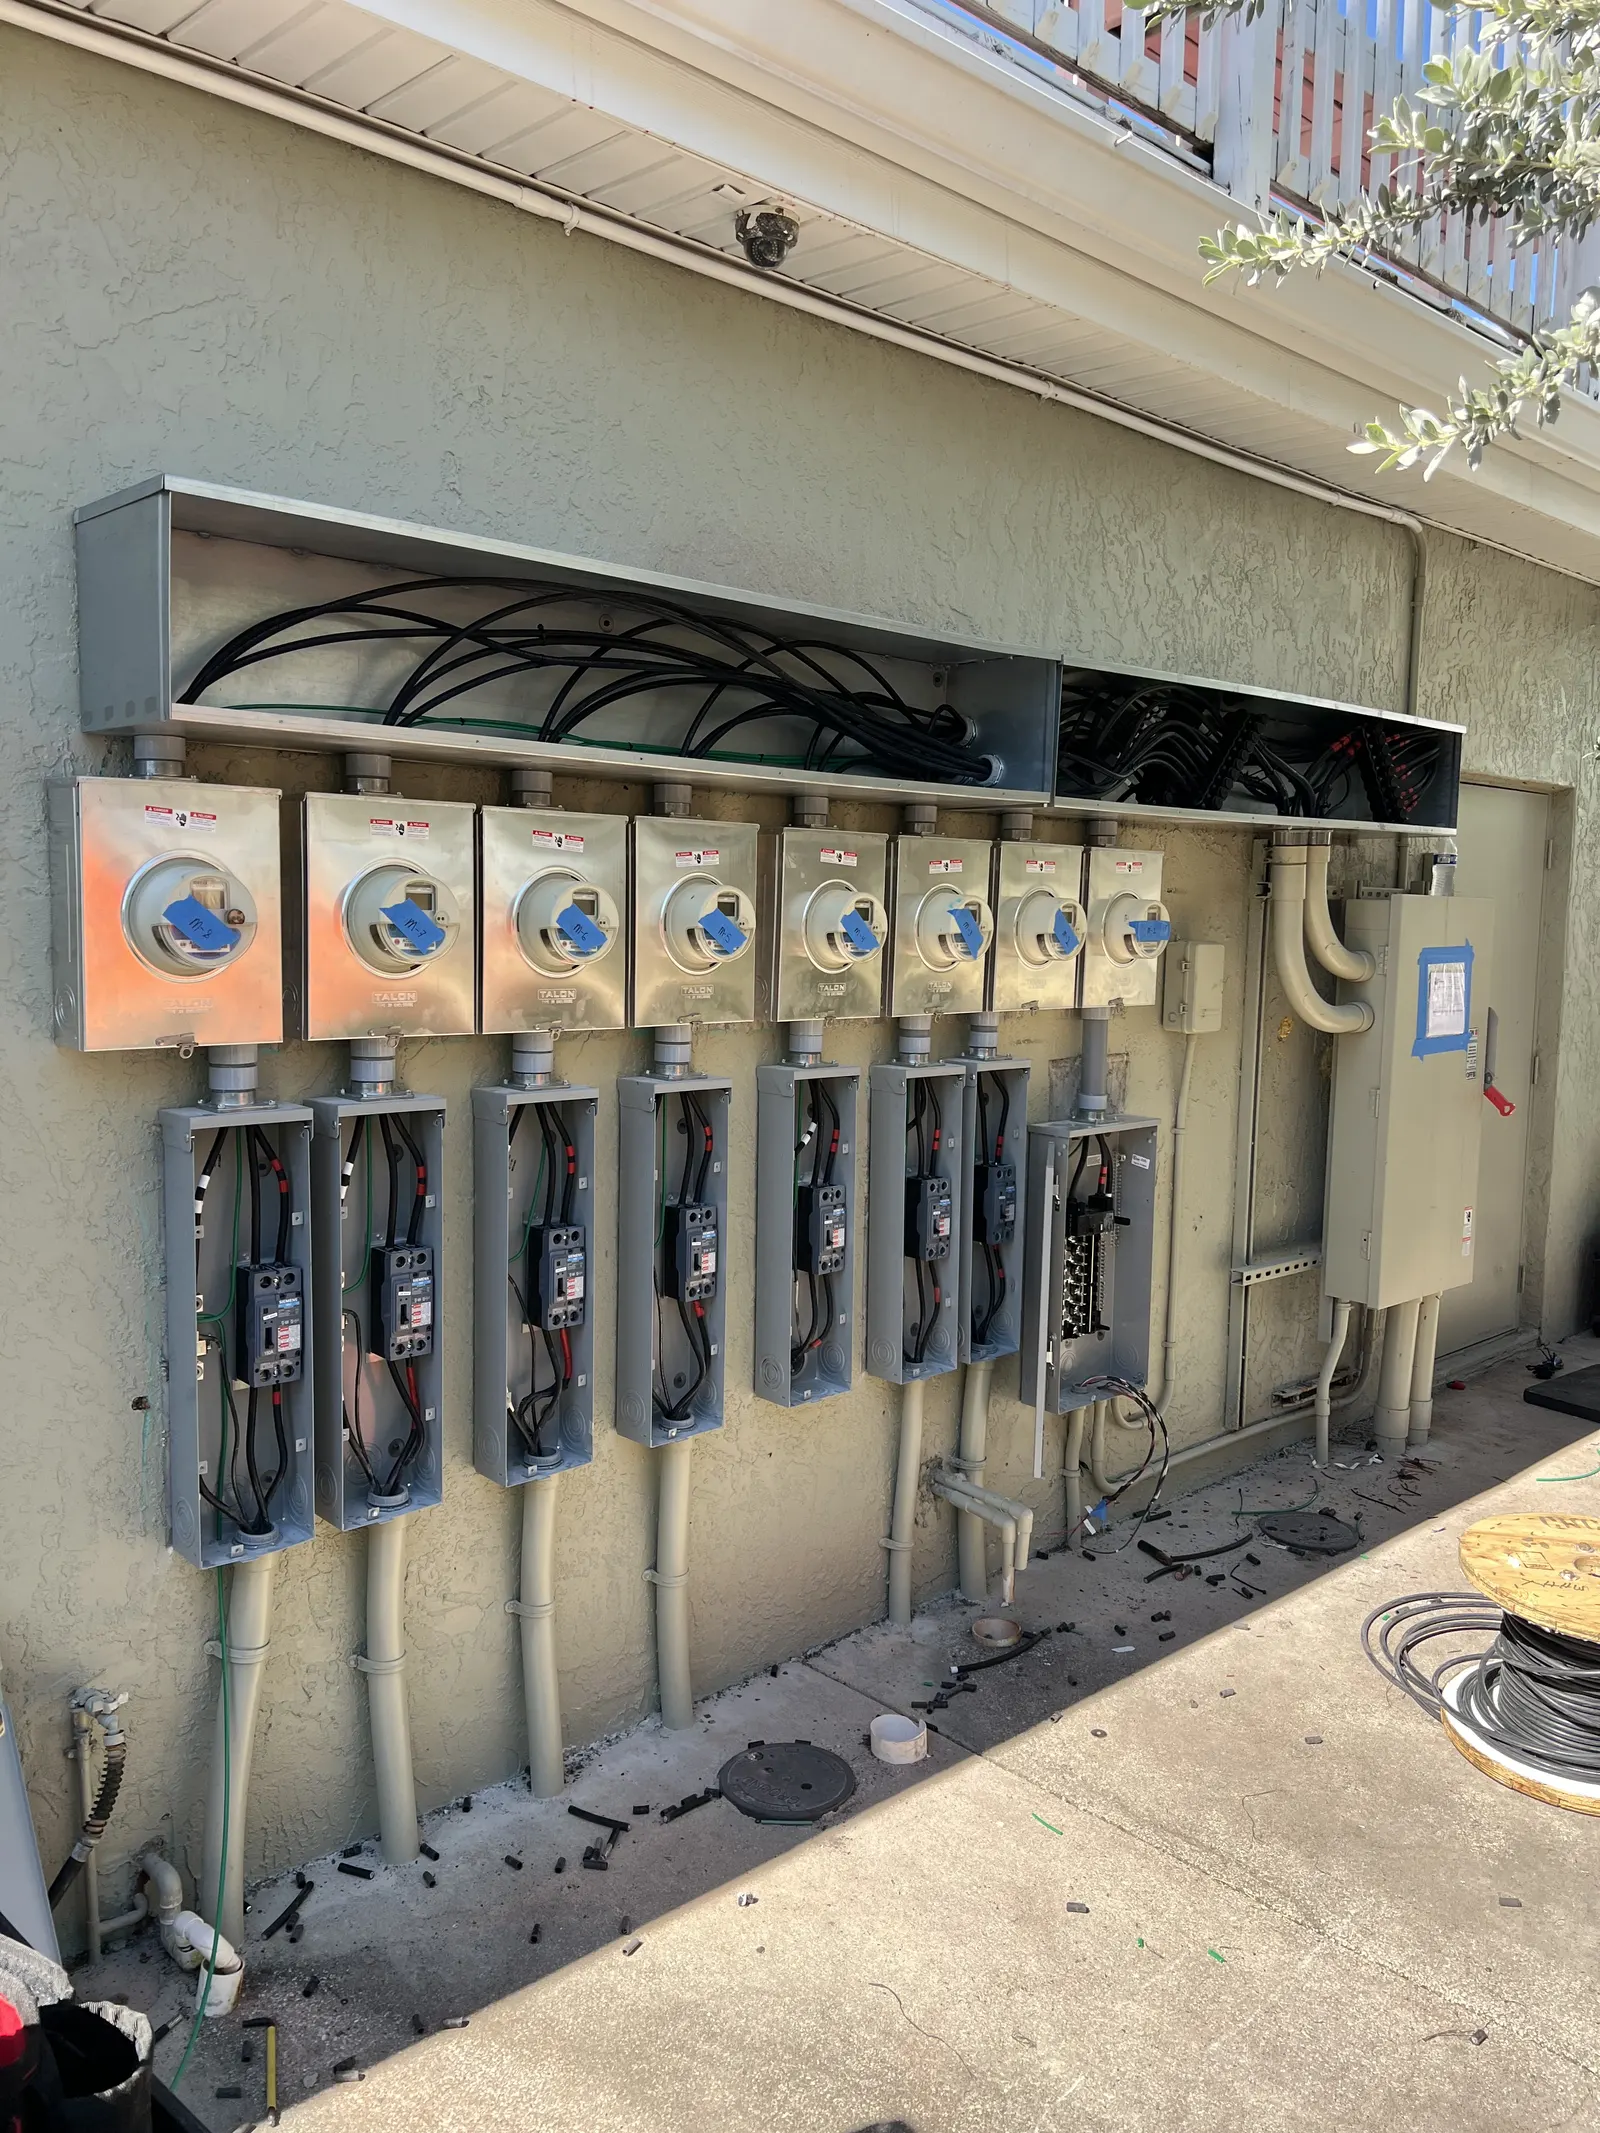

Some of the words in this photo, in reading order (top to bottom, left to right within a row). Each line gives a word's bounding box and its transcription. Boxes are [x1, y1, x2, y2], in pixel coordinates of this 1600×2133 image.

[540, 990, 575, 998] TALON
[683, 986, 713, 994] TALON
[374, 992, 416, 1001] TALON
